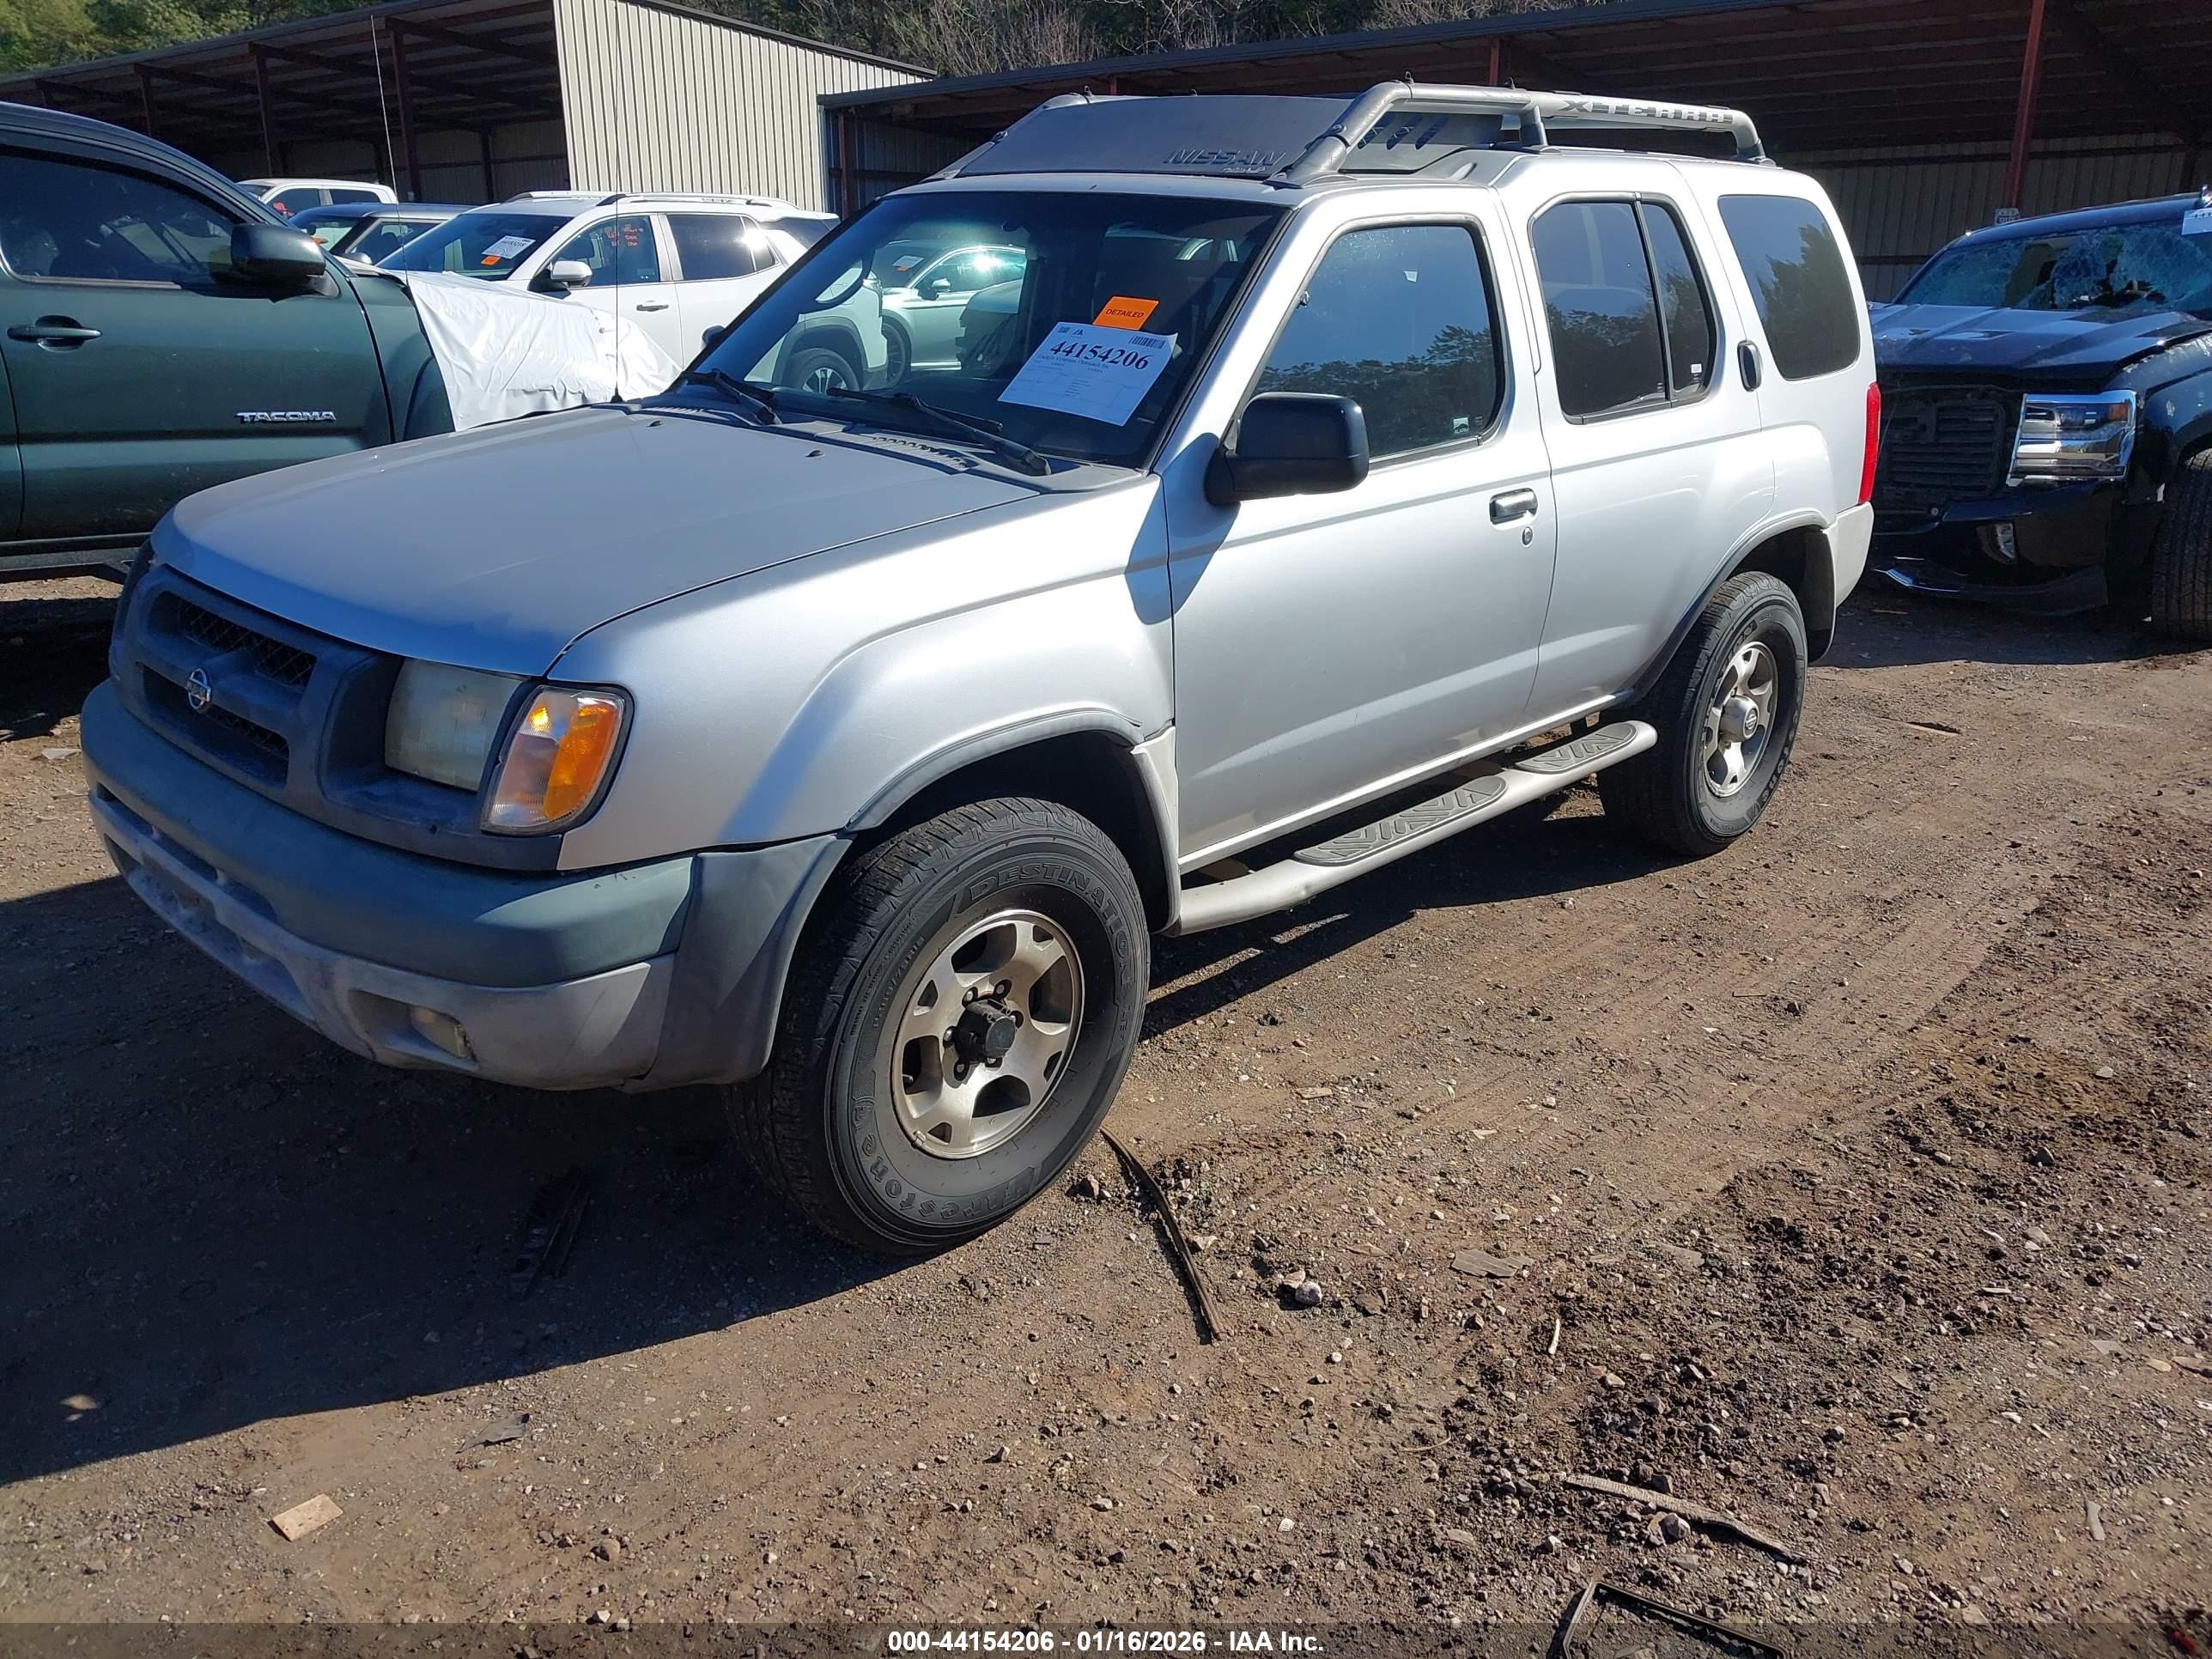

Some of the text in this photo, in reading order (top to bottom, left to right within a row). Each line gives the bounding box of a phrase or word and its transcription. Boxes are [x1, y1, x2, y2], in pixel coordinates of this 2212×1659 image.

[1559, 100, 1734, 125] XTERRA
[1163, 149, 1286, 167] NISSAN
[1105, 307, 1145, 319] DETAILED
[1050, 340, 1154, 370] 44154206
[236, 411, 337, 422] TACOMA
[969, 862, 1136, 988] DESTINATION
[861, 1132, 1024, 1219] Firestone
